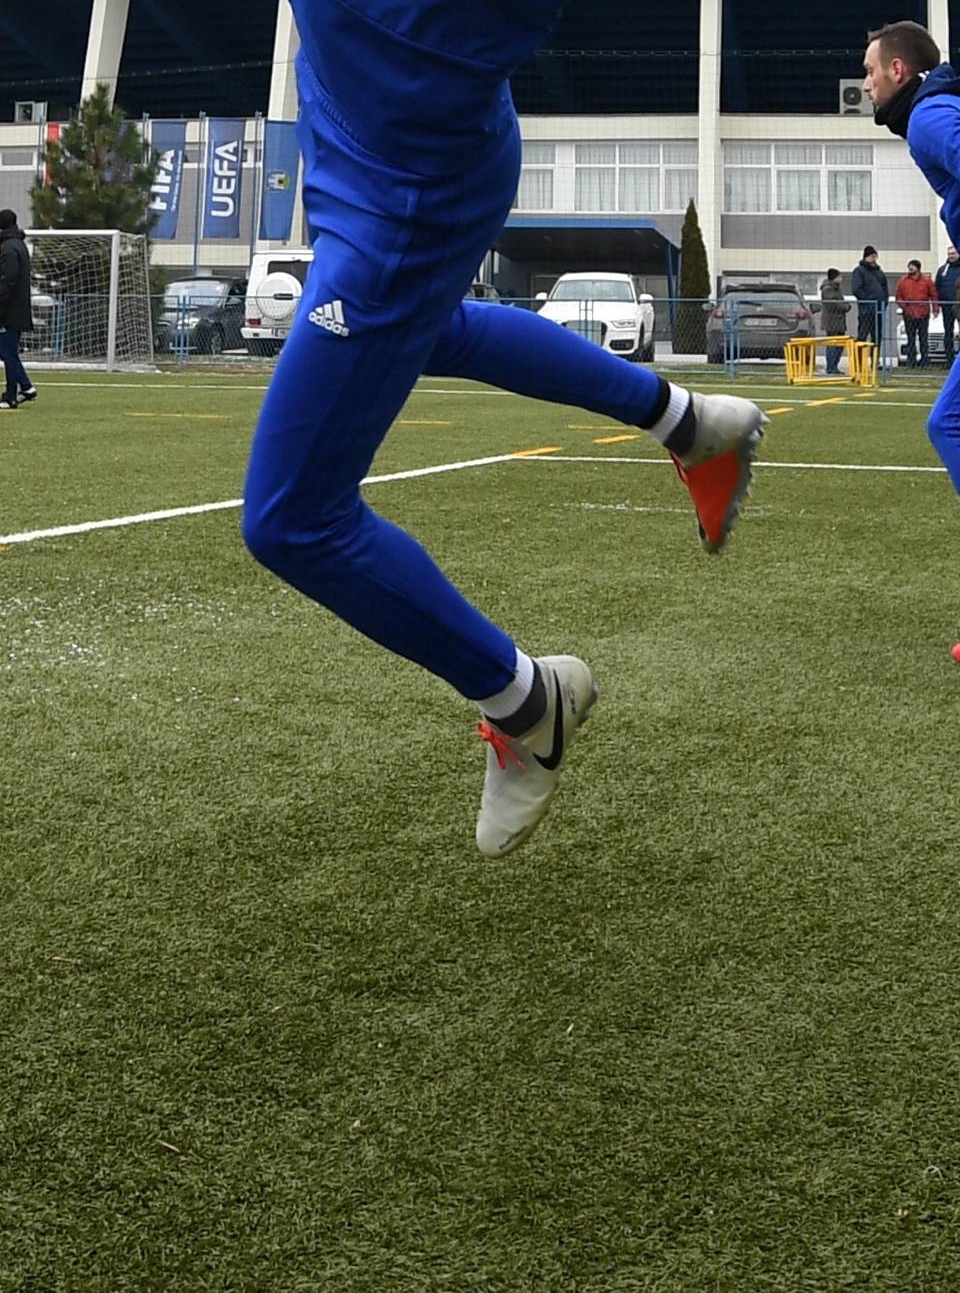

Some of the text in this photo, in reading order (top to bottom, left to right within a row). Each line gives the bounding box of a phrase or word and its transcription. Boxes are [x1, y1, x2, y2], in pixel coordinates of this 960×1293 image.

[149, 149, 175, 211] FIFA
[210, 140, 239, 218] UEFA
[308, 311, 350, 337] adidas
